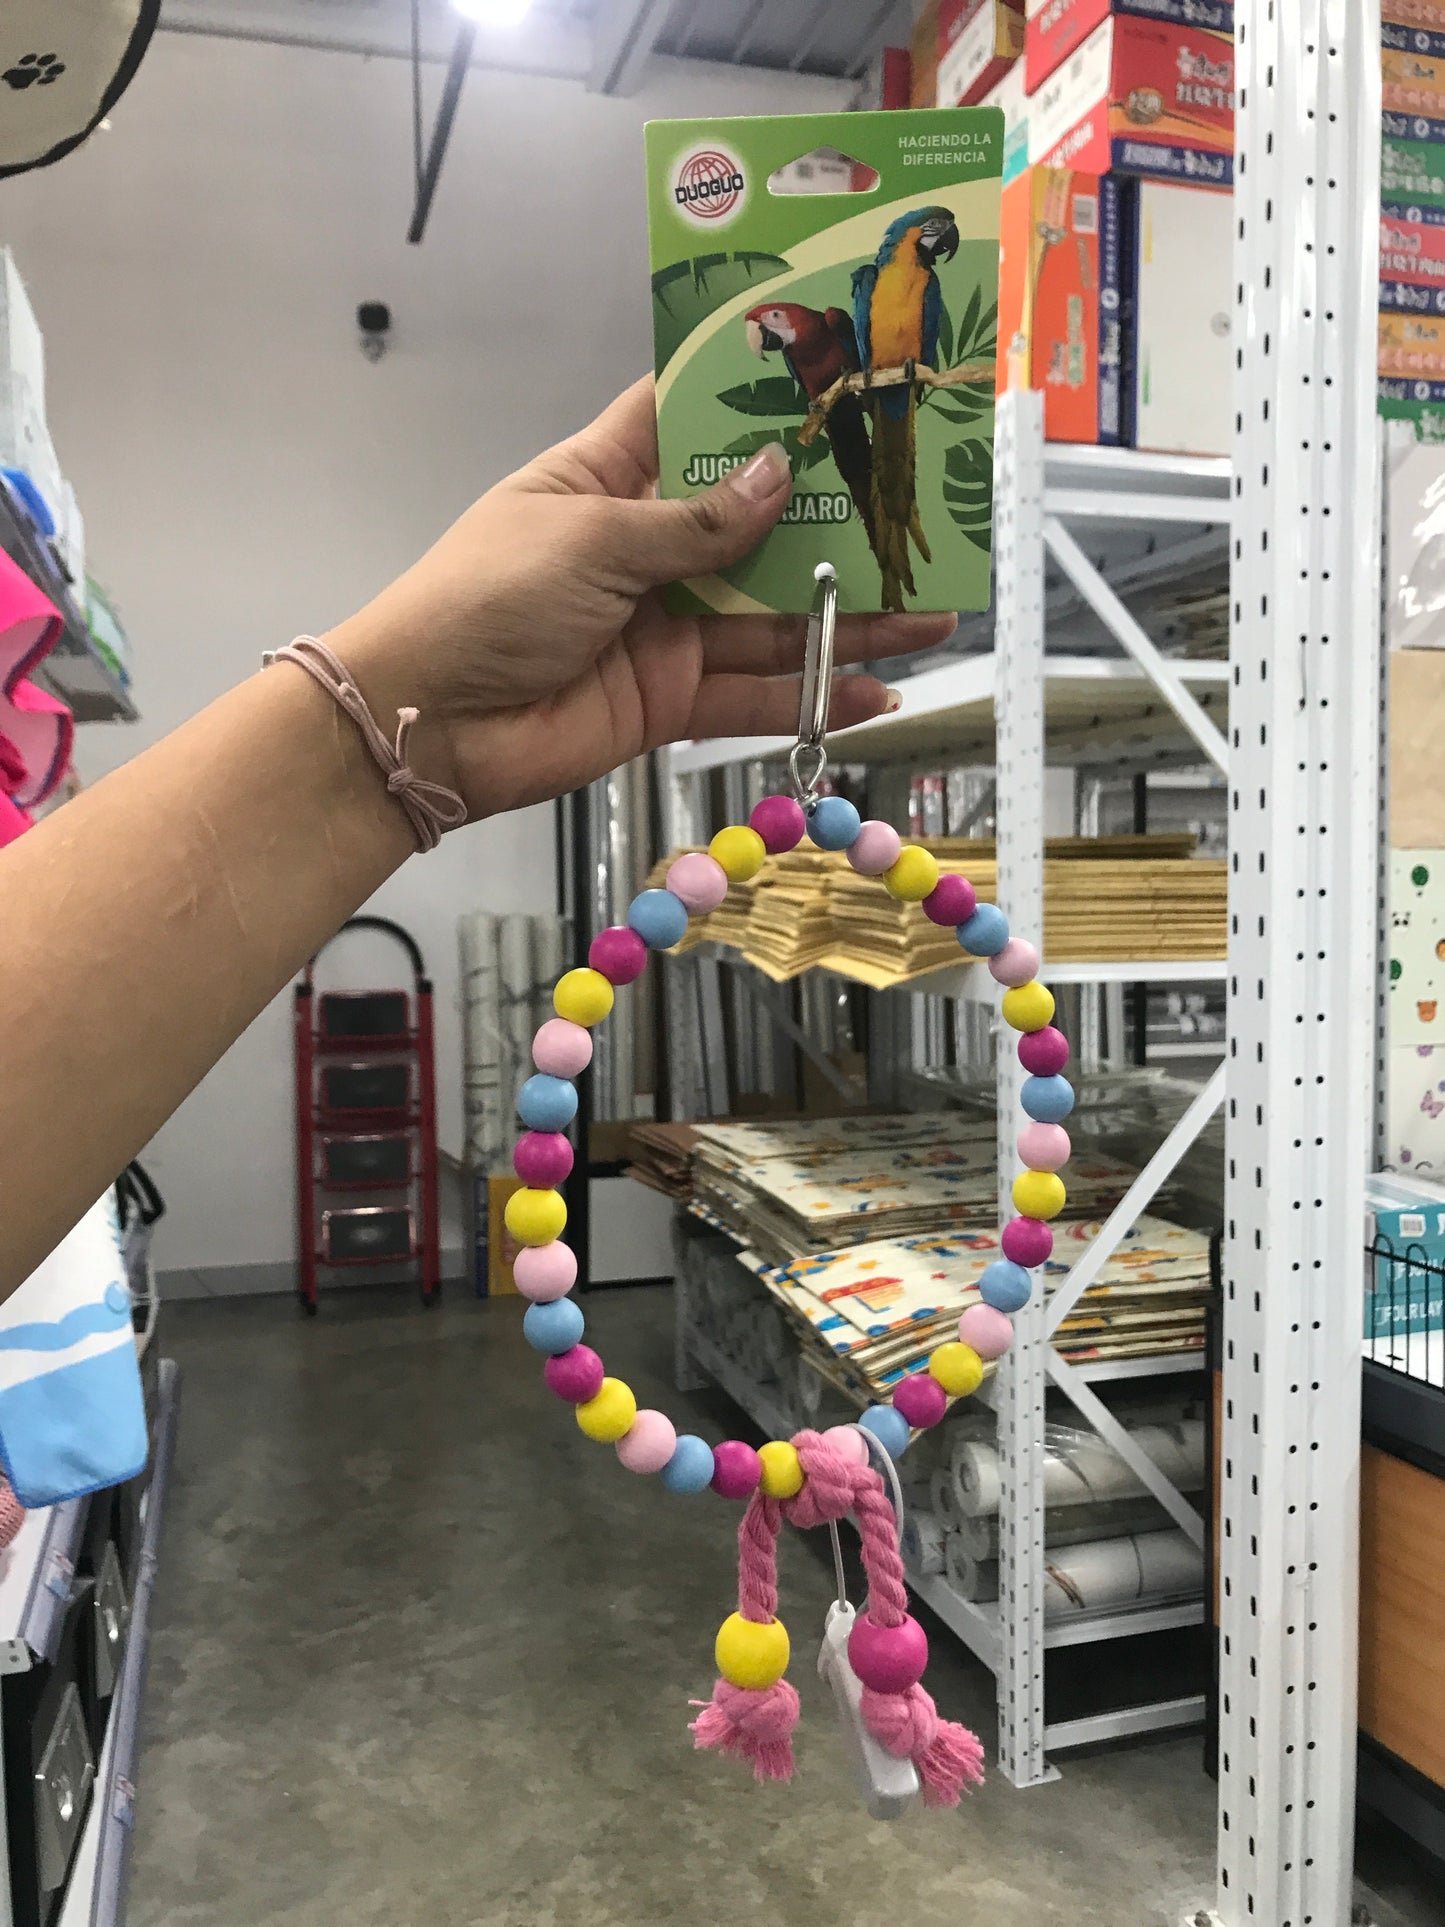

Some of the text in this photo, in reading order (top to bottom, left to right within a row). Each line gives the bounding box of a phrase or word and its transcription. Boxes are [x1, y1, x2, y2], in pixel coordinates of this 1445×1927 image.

[898, 132, 992, 149] HACIENDO LA
[902, 151, 986, 166] DIFERENCIA
[674, 172, 744, 205] DUOGUO
